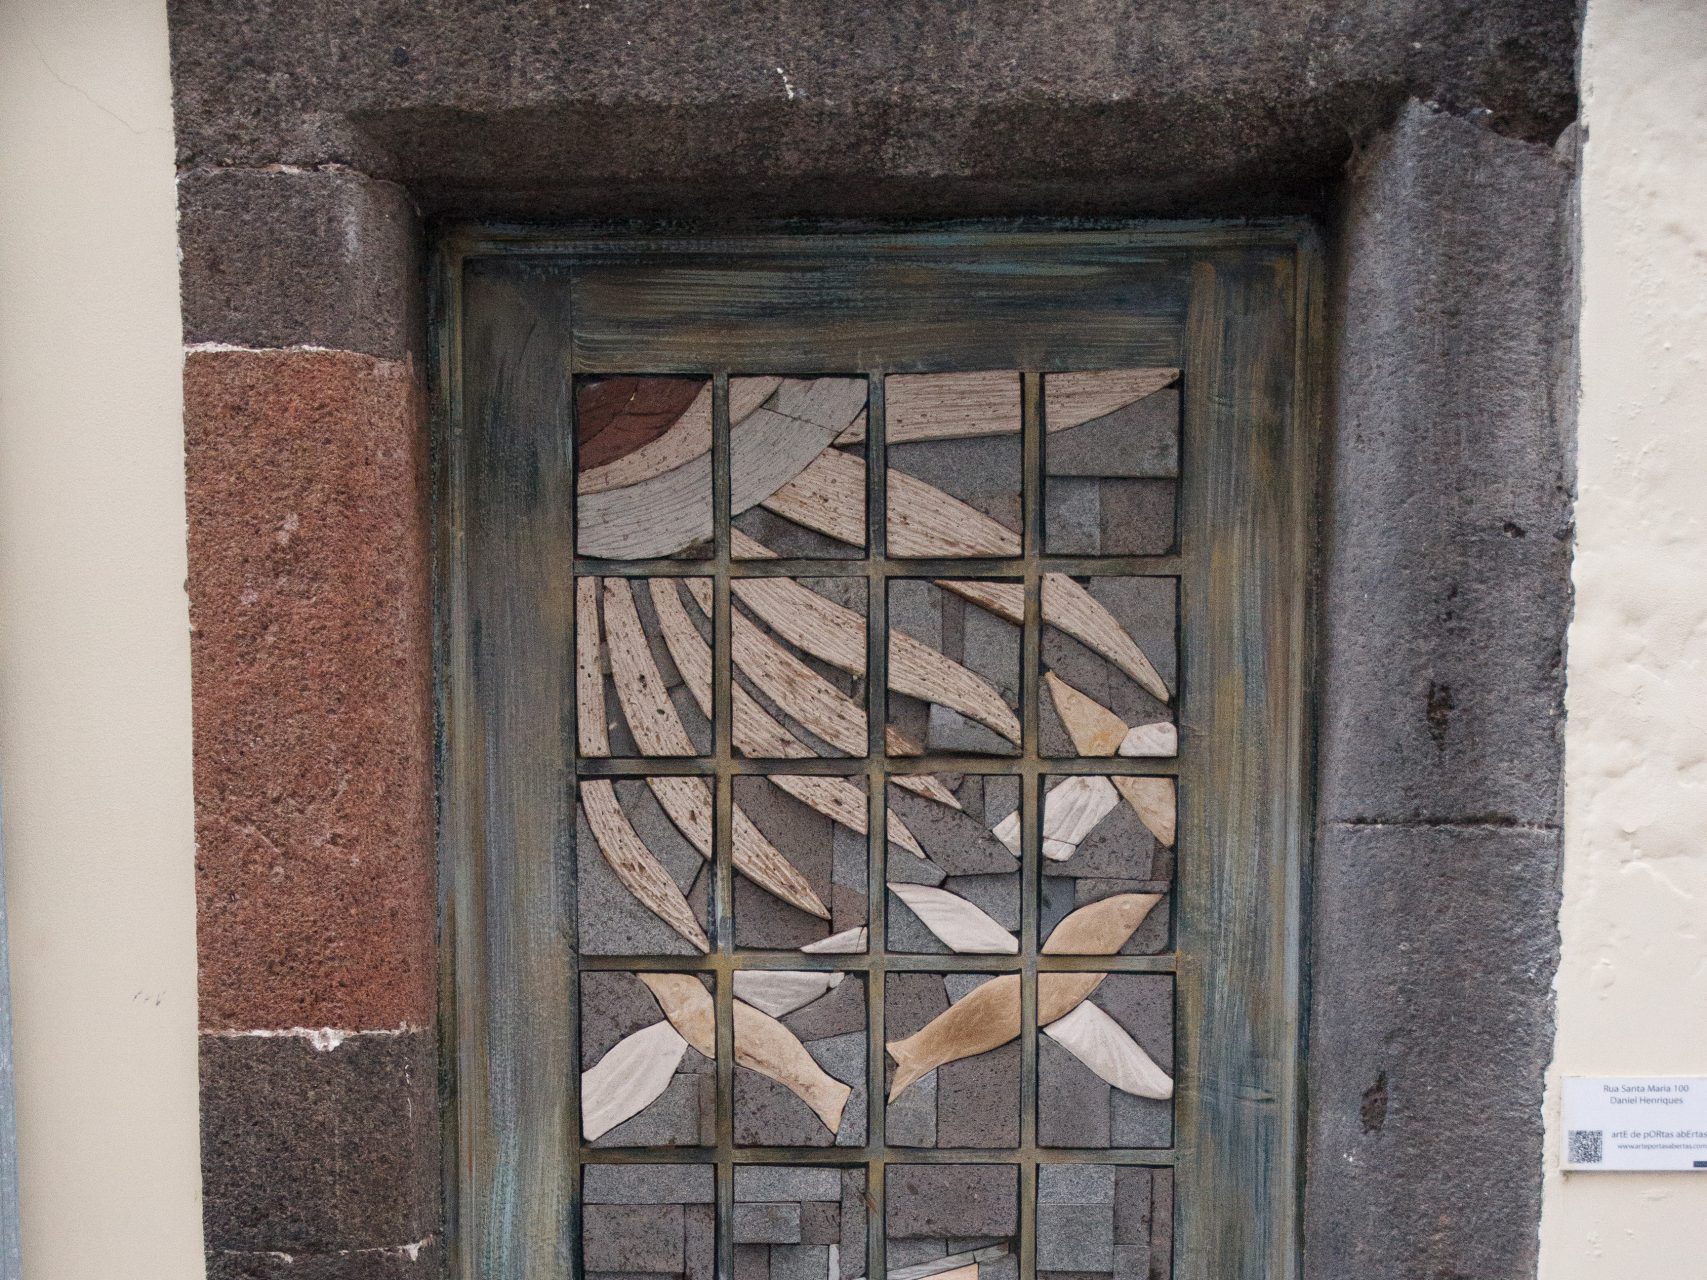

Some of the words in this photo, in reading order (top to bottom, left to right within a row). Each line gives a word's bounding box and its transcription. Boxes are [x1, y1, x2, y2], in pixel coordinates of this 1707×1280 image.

[1603, 1085, 1619, 1093] Rua
[1621, 1085, 1645, 1093] Santa
[1647, 1085, 1671, 1093] Maria
[1674, 1085, 1689, 1093] 100
[1610, 1096, 1637, 1104] Daniel
[1639, 1096, 1684, 1105] Henriques
[1611, 1130, 1628, 1138] artE
[1630, 1130, 1642, 1138] de
[1643, 1130, 1674, 1140] pORtas
